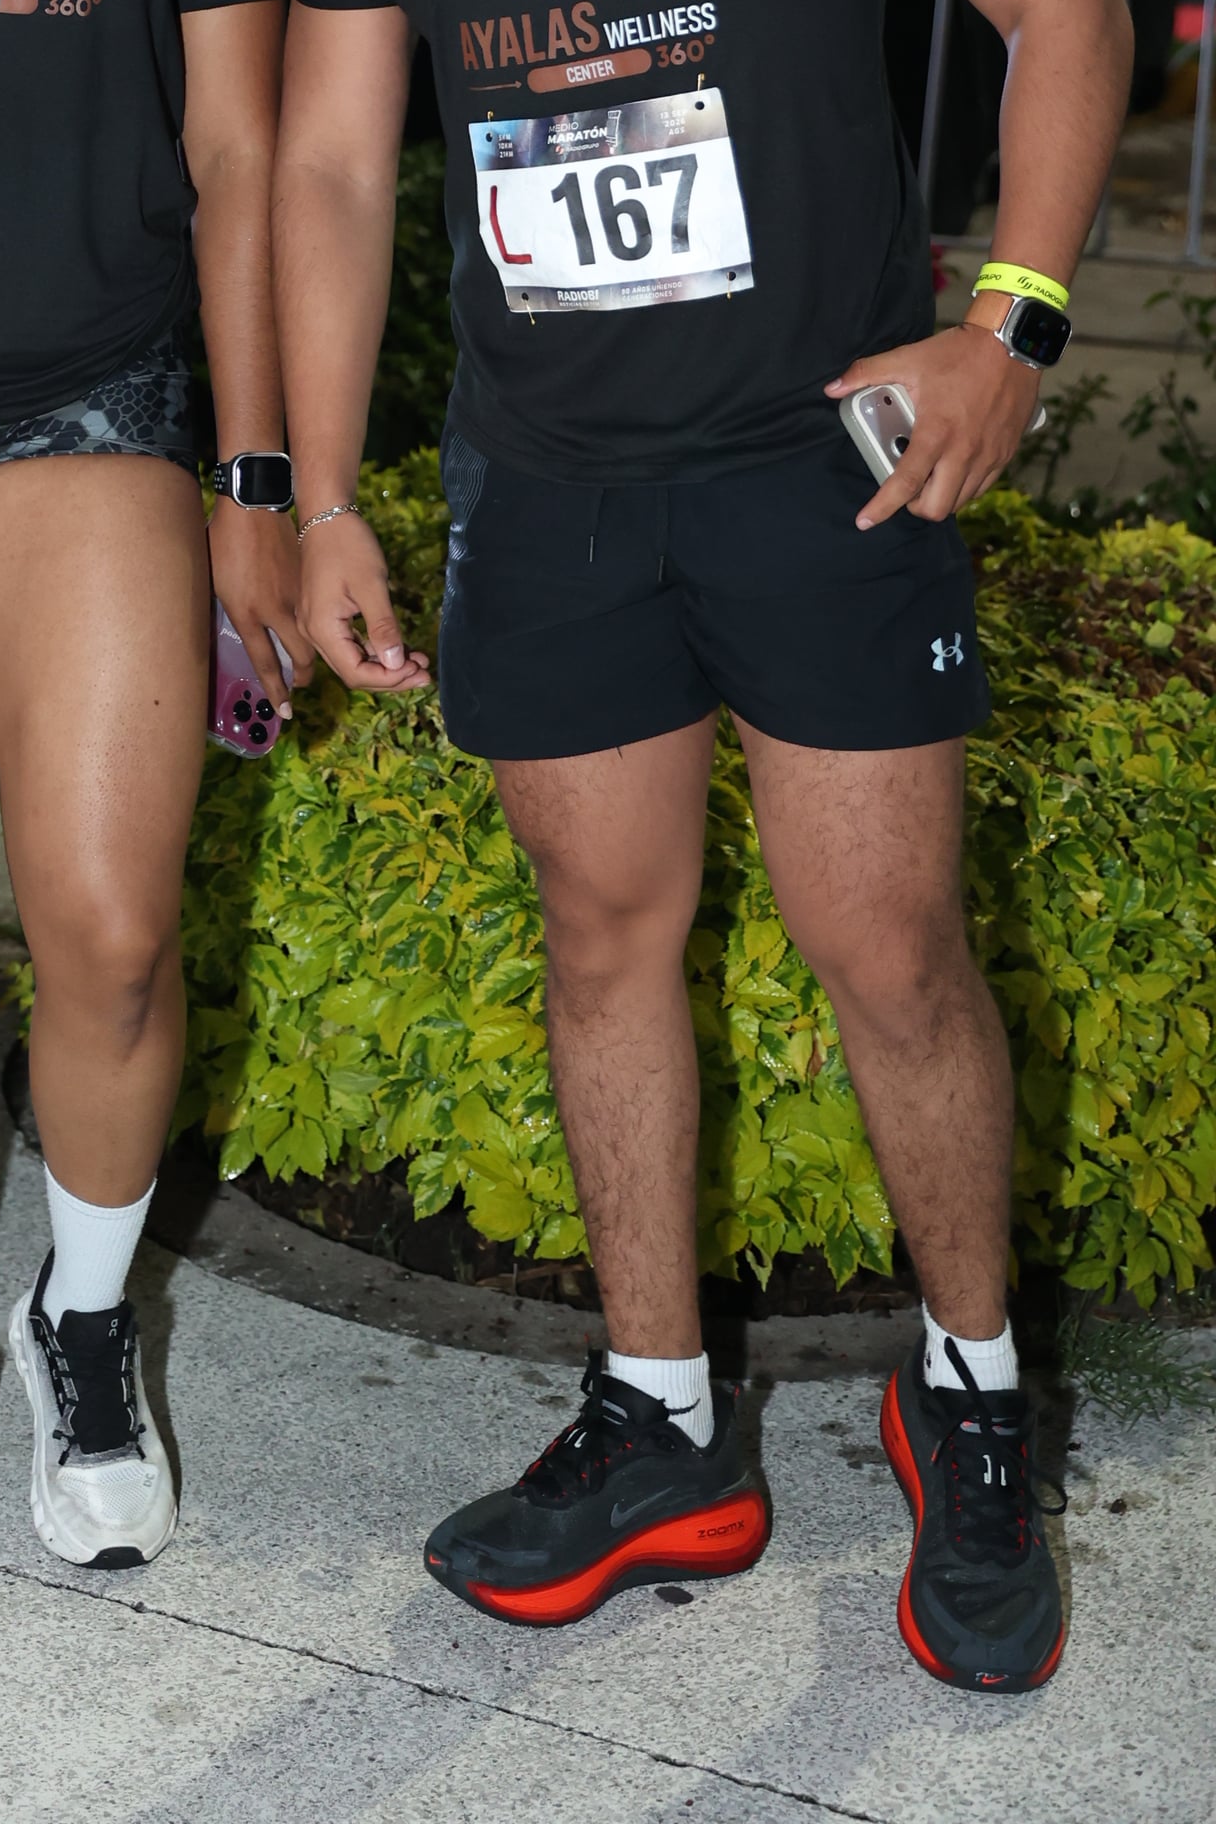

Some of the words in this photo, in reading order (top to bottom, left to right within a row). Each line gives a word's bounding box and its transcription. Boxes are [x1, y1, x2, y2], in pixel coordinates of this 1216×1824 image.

[459, 1, 600, 71] AYALAS
[603, 2, 717, 50] WELLNESS
[566, 59, 615, 84] CENTER
[547, 125, 608, 144] MARATÓN
[548, 121, 579, 133] MEDIO
[551, 152, 699, 266] 167
[556, 289, 600, 302] RADIOBI
